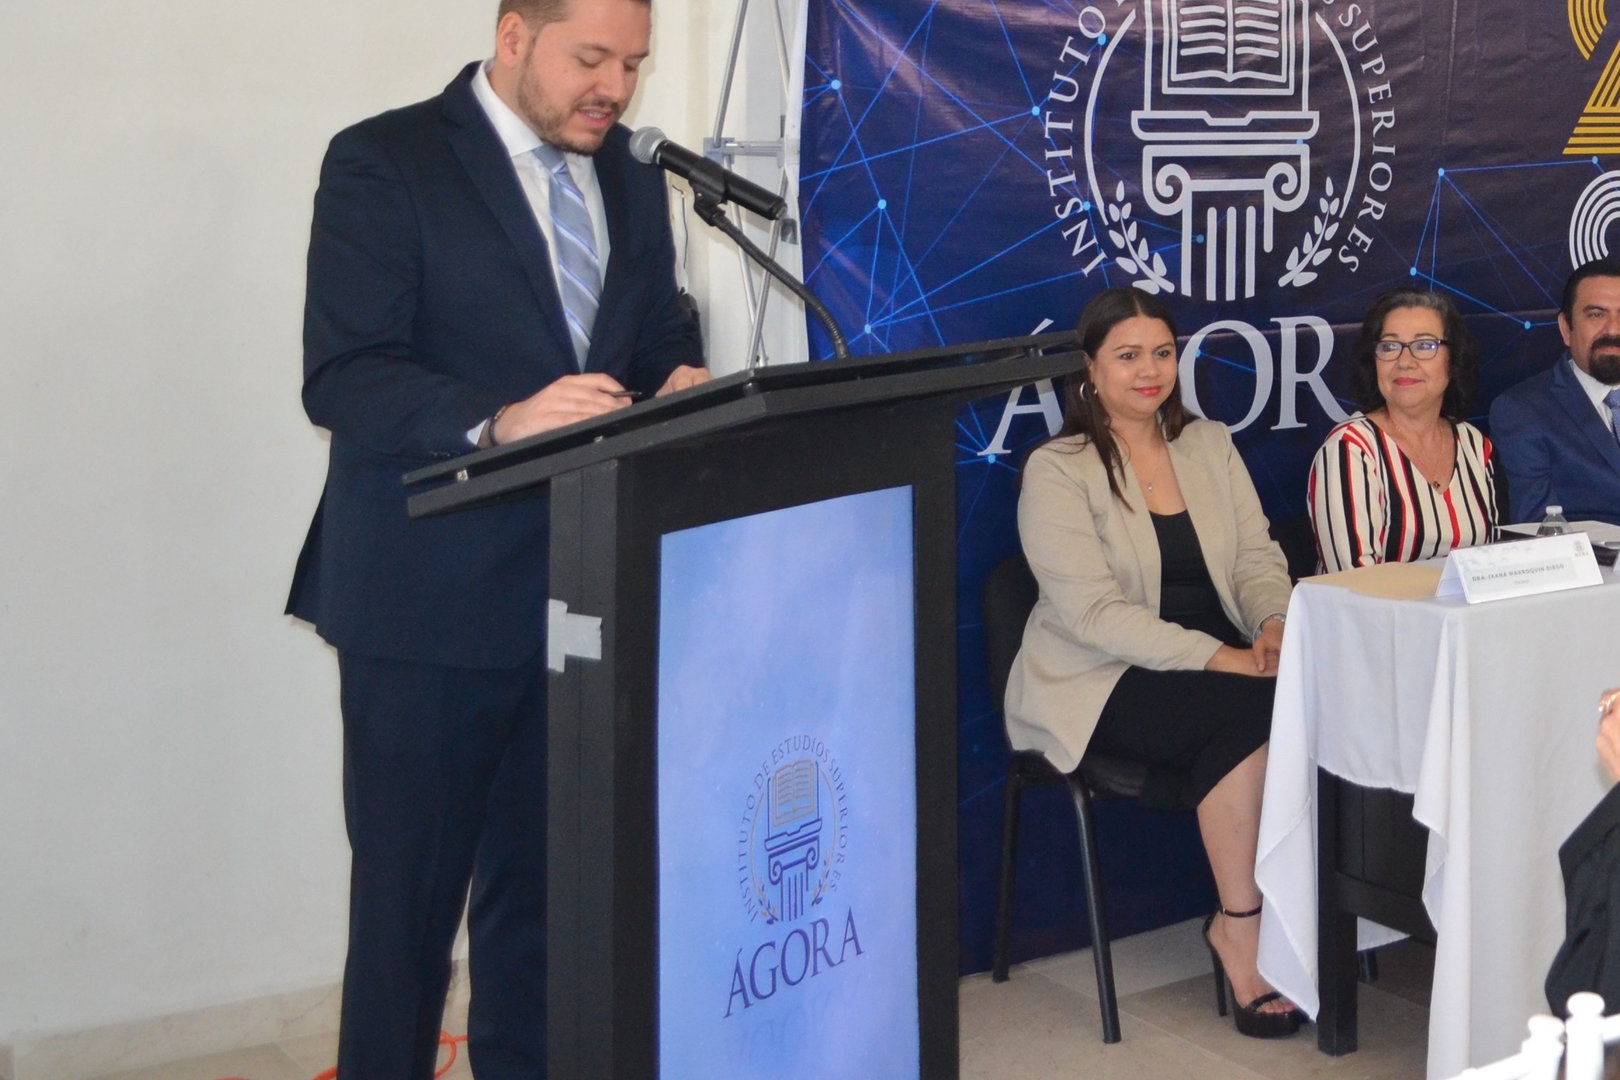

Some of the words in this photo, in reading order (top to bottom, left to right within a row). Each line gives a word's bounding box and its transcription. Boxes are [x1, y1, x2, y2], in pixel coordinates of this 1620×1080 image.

[1045, 5, 1107, 277] INSTITUTO
[1338, 3, 1396, 274] SUPERIORES
[738, 794, 758, 922] INSTITUTO
[754, 760, 770, 788] DE
[771, 734, 831, 764] ESTUDIOS
[828, 758, 848, 892] SUPERIORES
[723, 905, 864, 1019] ÁGORA
